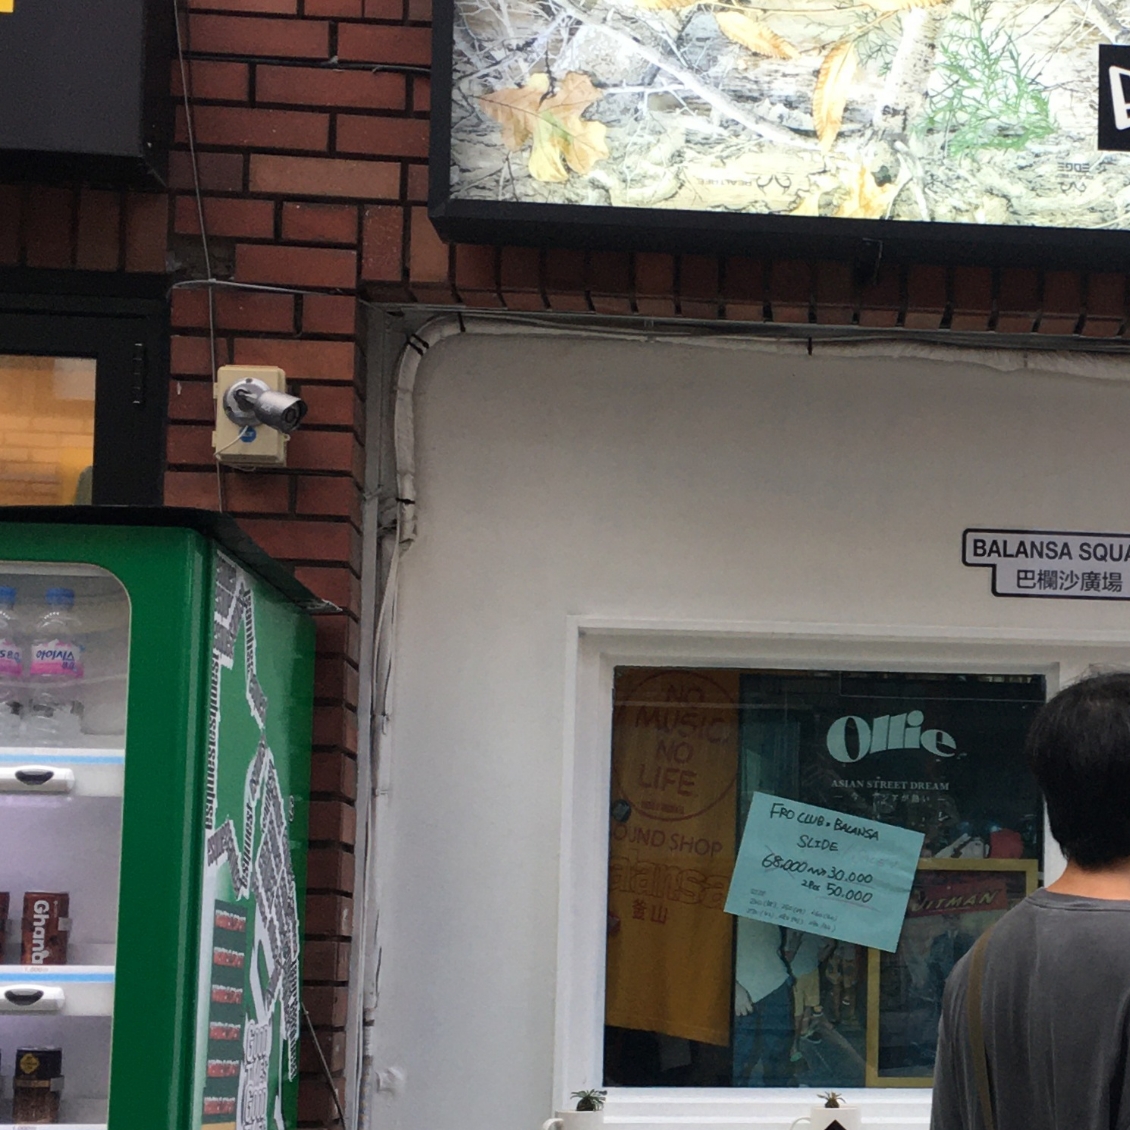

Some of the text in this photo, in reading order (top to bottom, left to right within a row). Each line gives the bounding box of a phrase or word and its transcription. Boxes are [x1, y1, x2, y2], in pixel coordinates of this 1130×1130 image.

[972, 538, 1074, 560] BALANSA
[826, 709, 957, 763] Ollie
[656, 740, 694, 764] NO
[831, 780, 950, 790] ASIAN STREET DREAM
[834, 818, 880, 841] BALANSA
[669, 833, 723, 857] SHOP
[796, 835, 839, 852] SLIDE
[827, 867, 873, 885] 30.000
[826, 884, 873, 904] 50.000
[31, 899, 51, 965] Ghana
